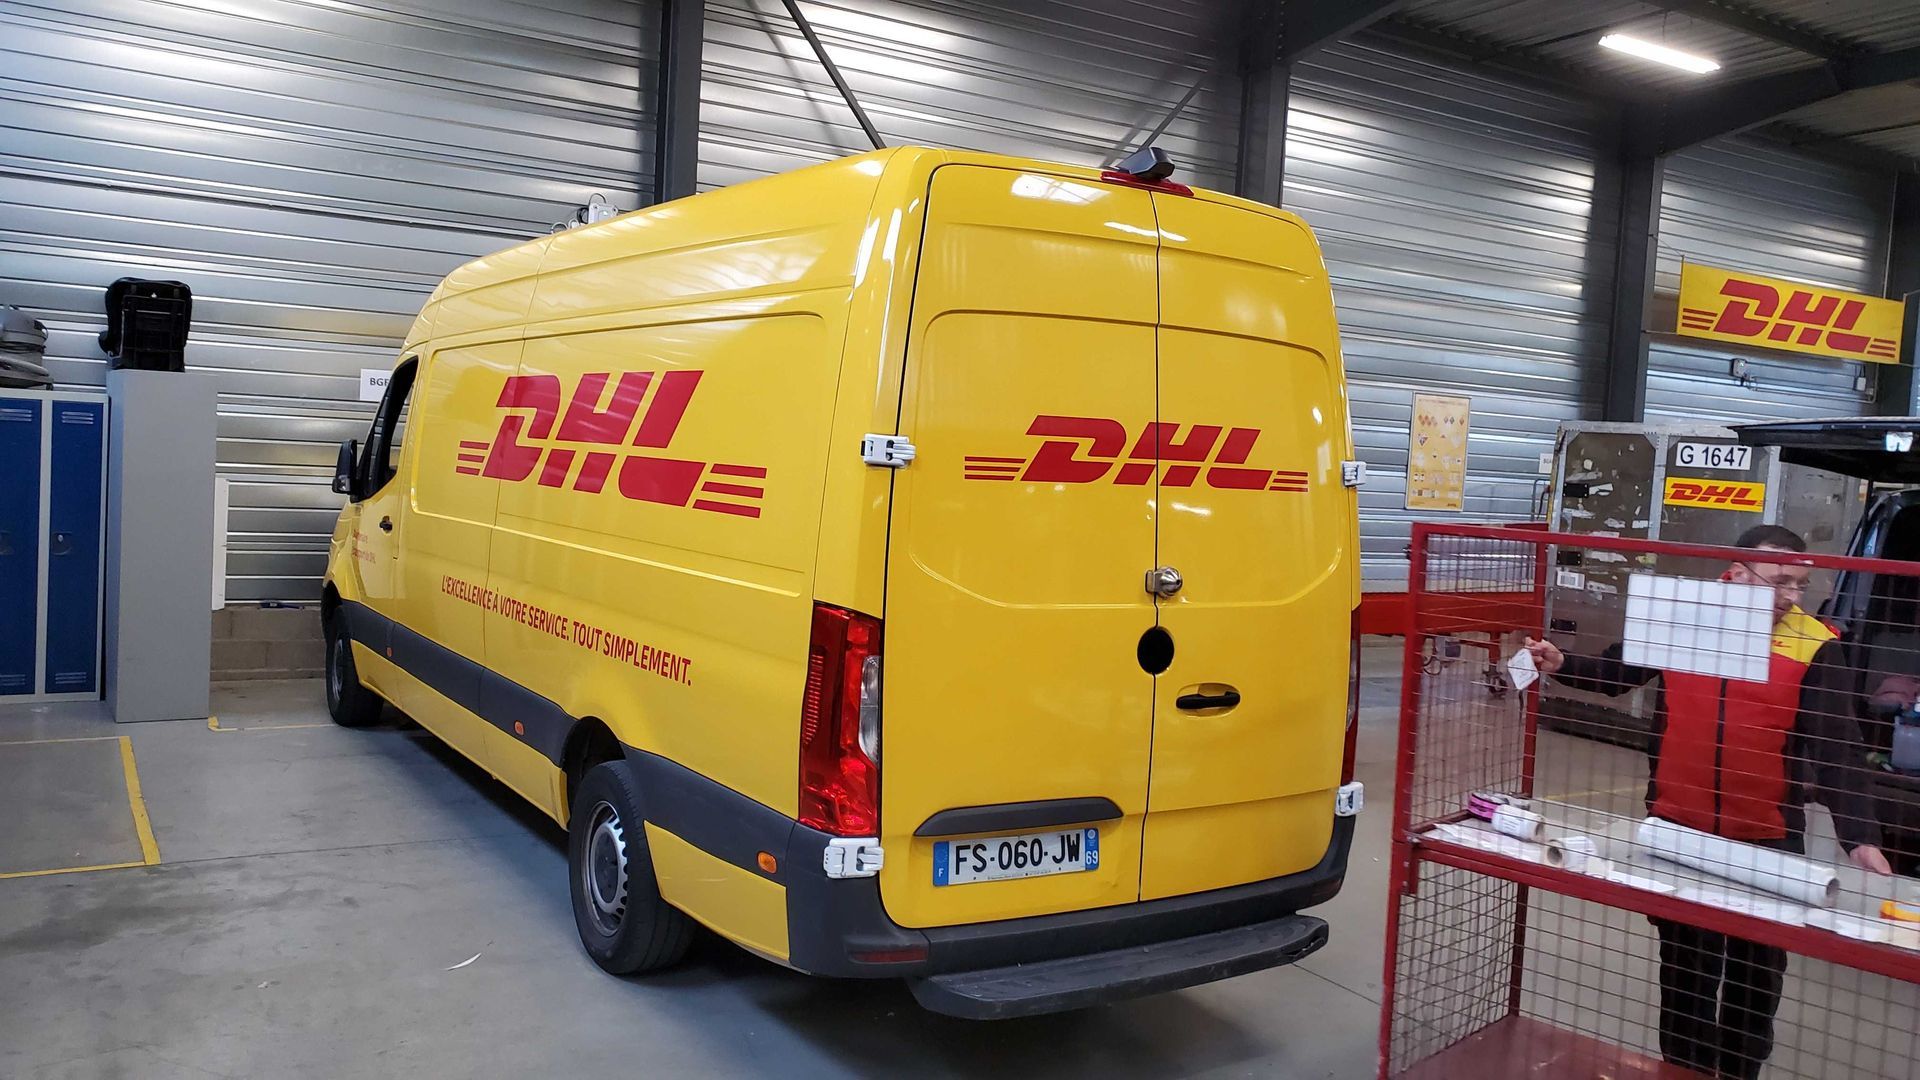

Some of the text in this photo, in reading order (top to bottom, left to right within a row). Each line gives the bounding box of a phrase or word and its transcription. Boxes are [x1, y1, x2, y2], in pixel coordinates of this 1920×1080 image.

[1712, 278, 1872, 354] DHL
[482, 370, 706, 507] DHL
[1020, 415, 1274, 490] DHL
[1680, 445, 1748, 467] G 1647
[1669, 483, 1758, 506] DHL
[441, 575, 692, 687] L'EXCELLENCE À VOTRE SERVICE. TOUT SIMPLEMENT.
[938, 867, 945, 878] F
[1085, 849, 1099, 865] 69
